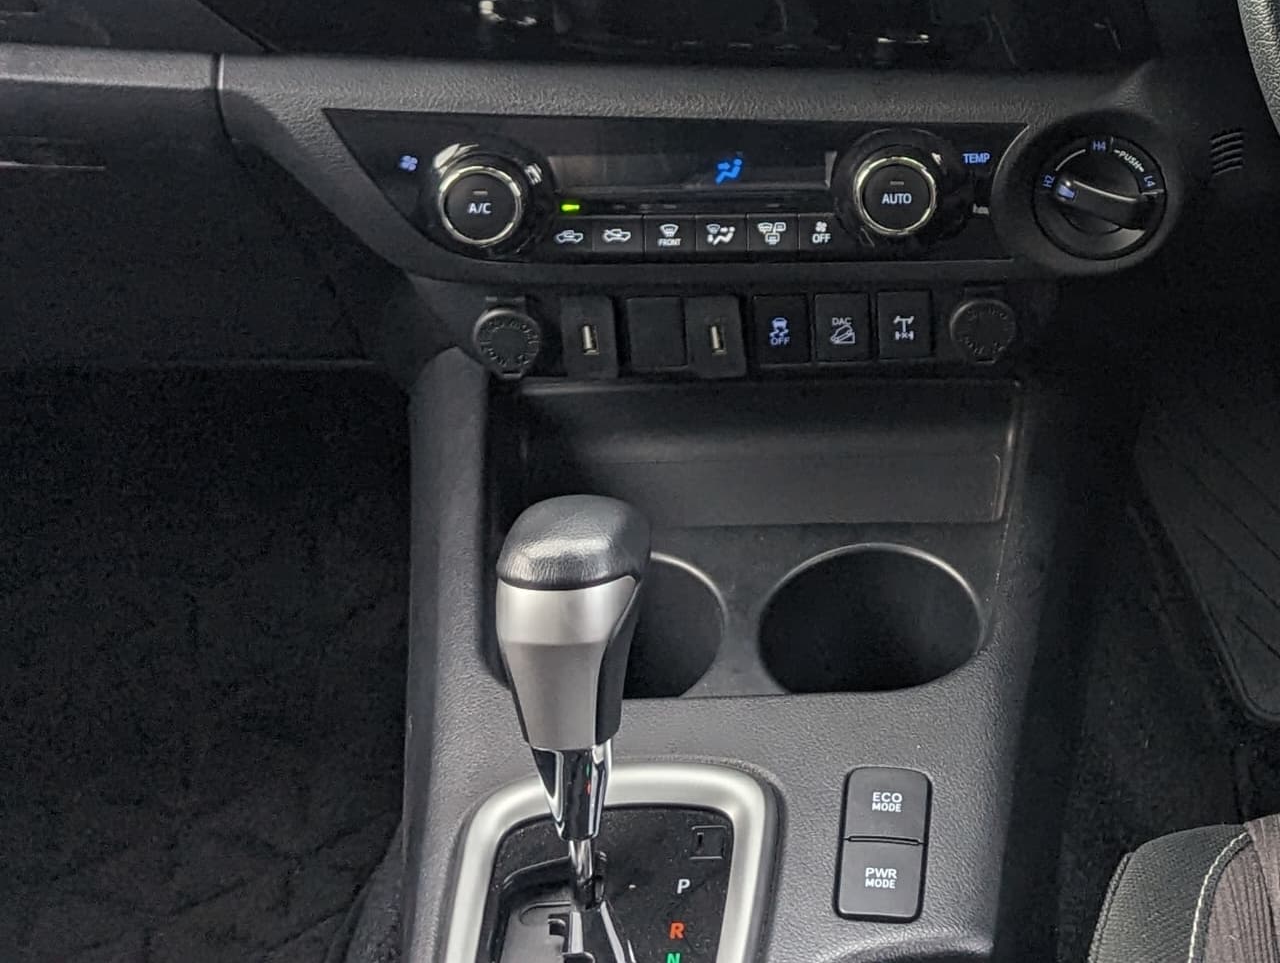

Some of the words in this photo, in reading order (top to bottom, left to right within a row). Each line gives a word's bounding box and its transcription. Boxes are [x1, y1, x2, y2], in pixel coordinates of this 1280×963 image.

[1092, 140, 1107, 151] H4
[962, 152, 991, 164] TEMP
[881, 192, 913, 205] AUTO
[468, 202, 492, 214] A/C
[657, 238, 682, 247] FRONT
[812, 233, 832, 244] OFF
[832, 317, 852, 326] DAC
[770, 337, 790, 346] OFF
[872, 791, 903, 803] ECO
[871, 802, 902, 812] MODE
[865, 867, 897, 879] PWR
[676, 878, 691, 894] P
[864, 878, 896, 889] MODE
[669, 922, 685, 940] R
[666, 952, 681, 963] N
